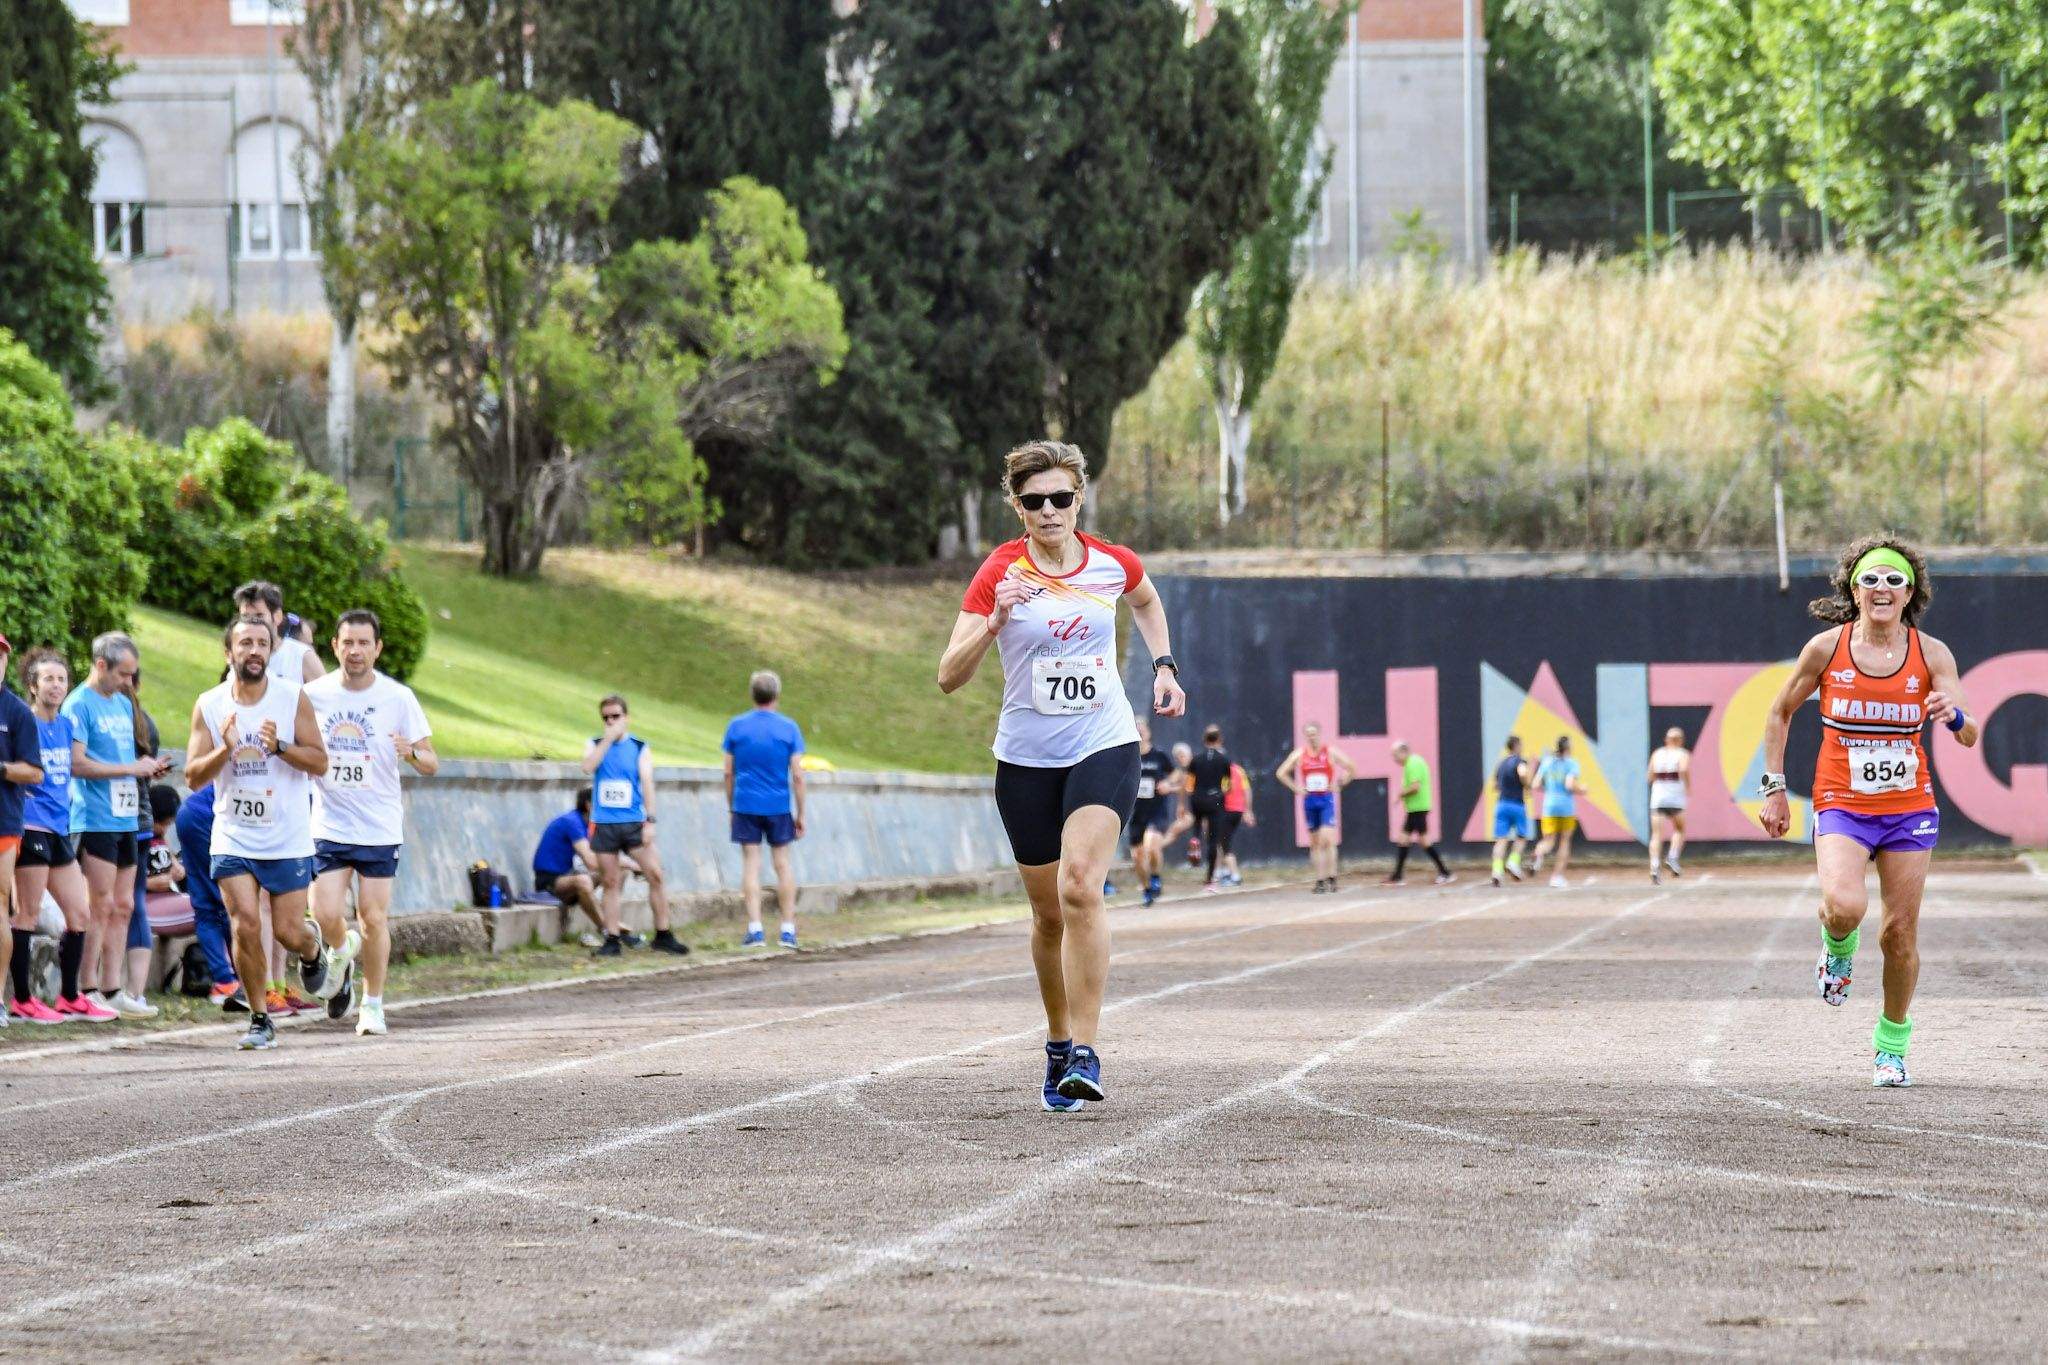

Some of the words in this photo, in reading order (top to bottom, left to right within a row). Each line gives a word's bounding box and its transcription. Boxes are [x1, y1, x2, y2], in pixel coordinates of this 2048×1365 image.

[1046, 676, 1096, 701] 706
[1831, 697, 1921, 723] MADRID
[332, 766, 364, 782] 738
[1863, 760, 1907, 781] 854
[233, 798, 265, 817] 730
